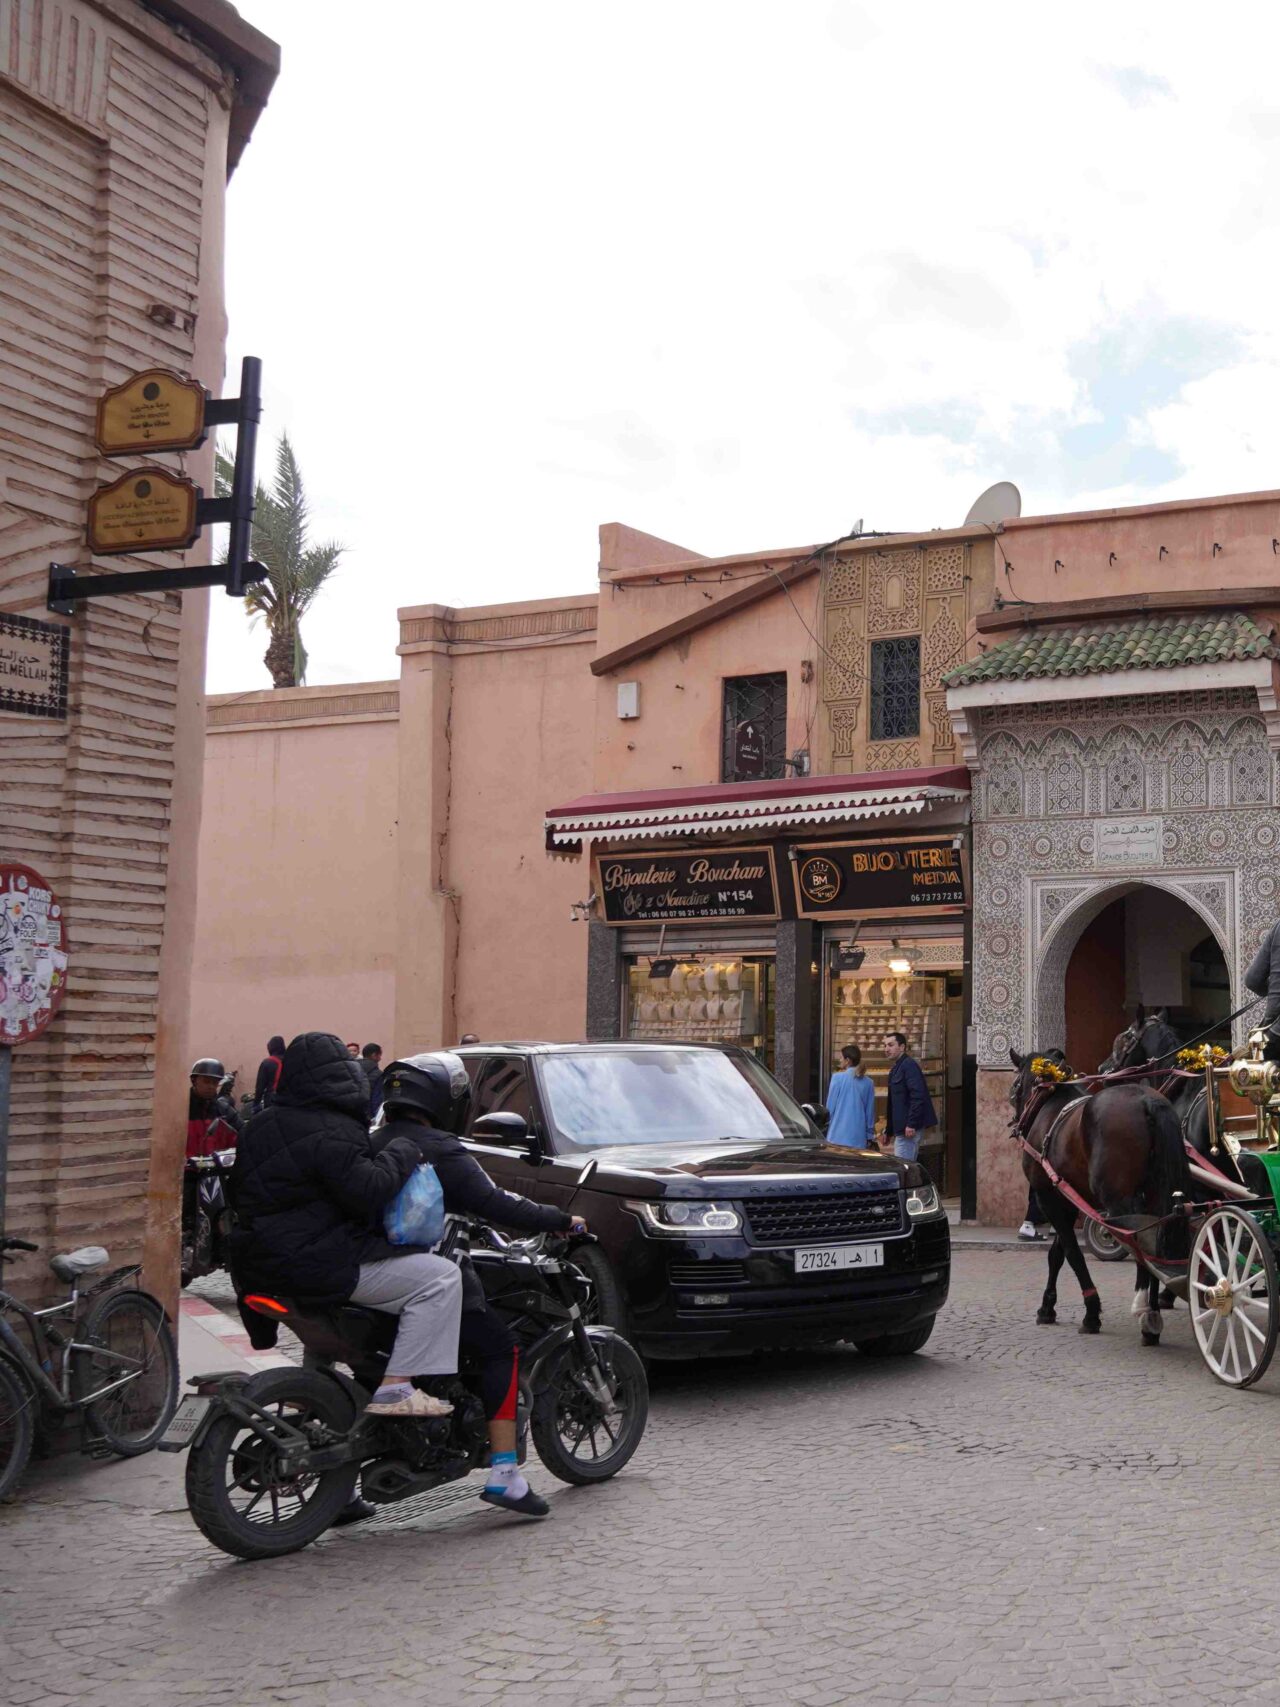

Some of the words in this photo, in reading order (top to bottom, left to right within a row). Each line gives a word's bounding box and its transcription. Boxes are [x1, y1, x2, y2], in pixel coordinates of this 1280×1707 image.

[852, 848, 959, 873] BIJOUTERIE
[605, 864, 677, 892] Bijouterie
[687, 858, 766, 884] Boucham
[812, 875, 828, 887] BM
[912, 870, 961, 886] MEDIA
[718, 890, 754, 903] N°154
[910, 894, 920, 902] 06
[921, 894, 930, 902] 73
[932, 893, 942, 901] 73
[942, 892, 952, 900] 72
[953, 892, 963, 900] 82
[750, 1184, 818, 1194] RANGE
[831, 1178, 892, 1190] ROVER
[801, 1252, 837, 1270] 27324
